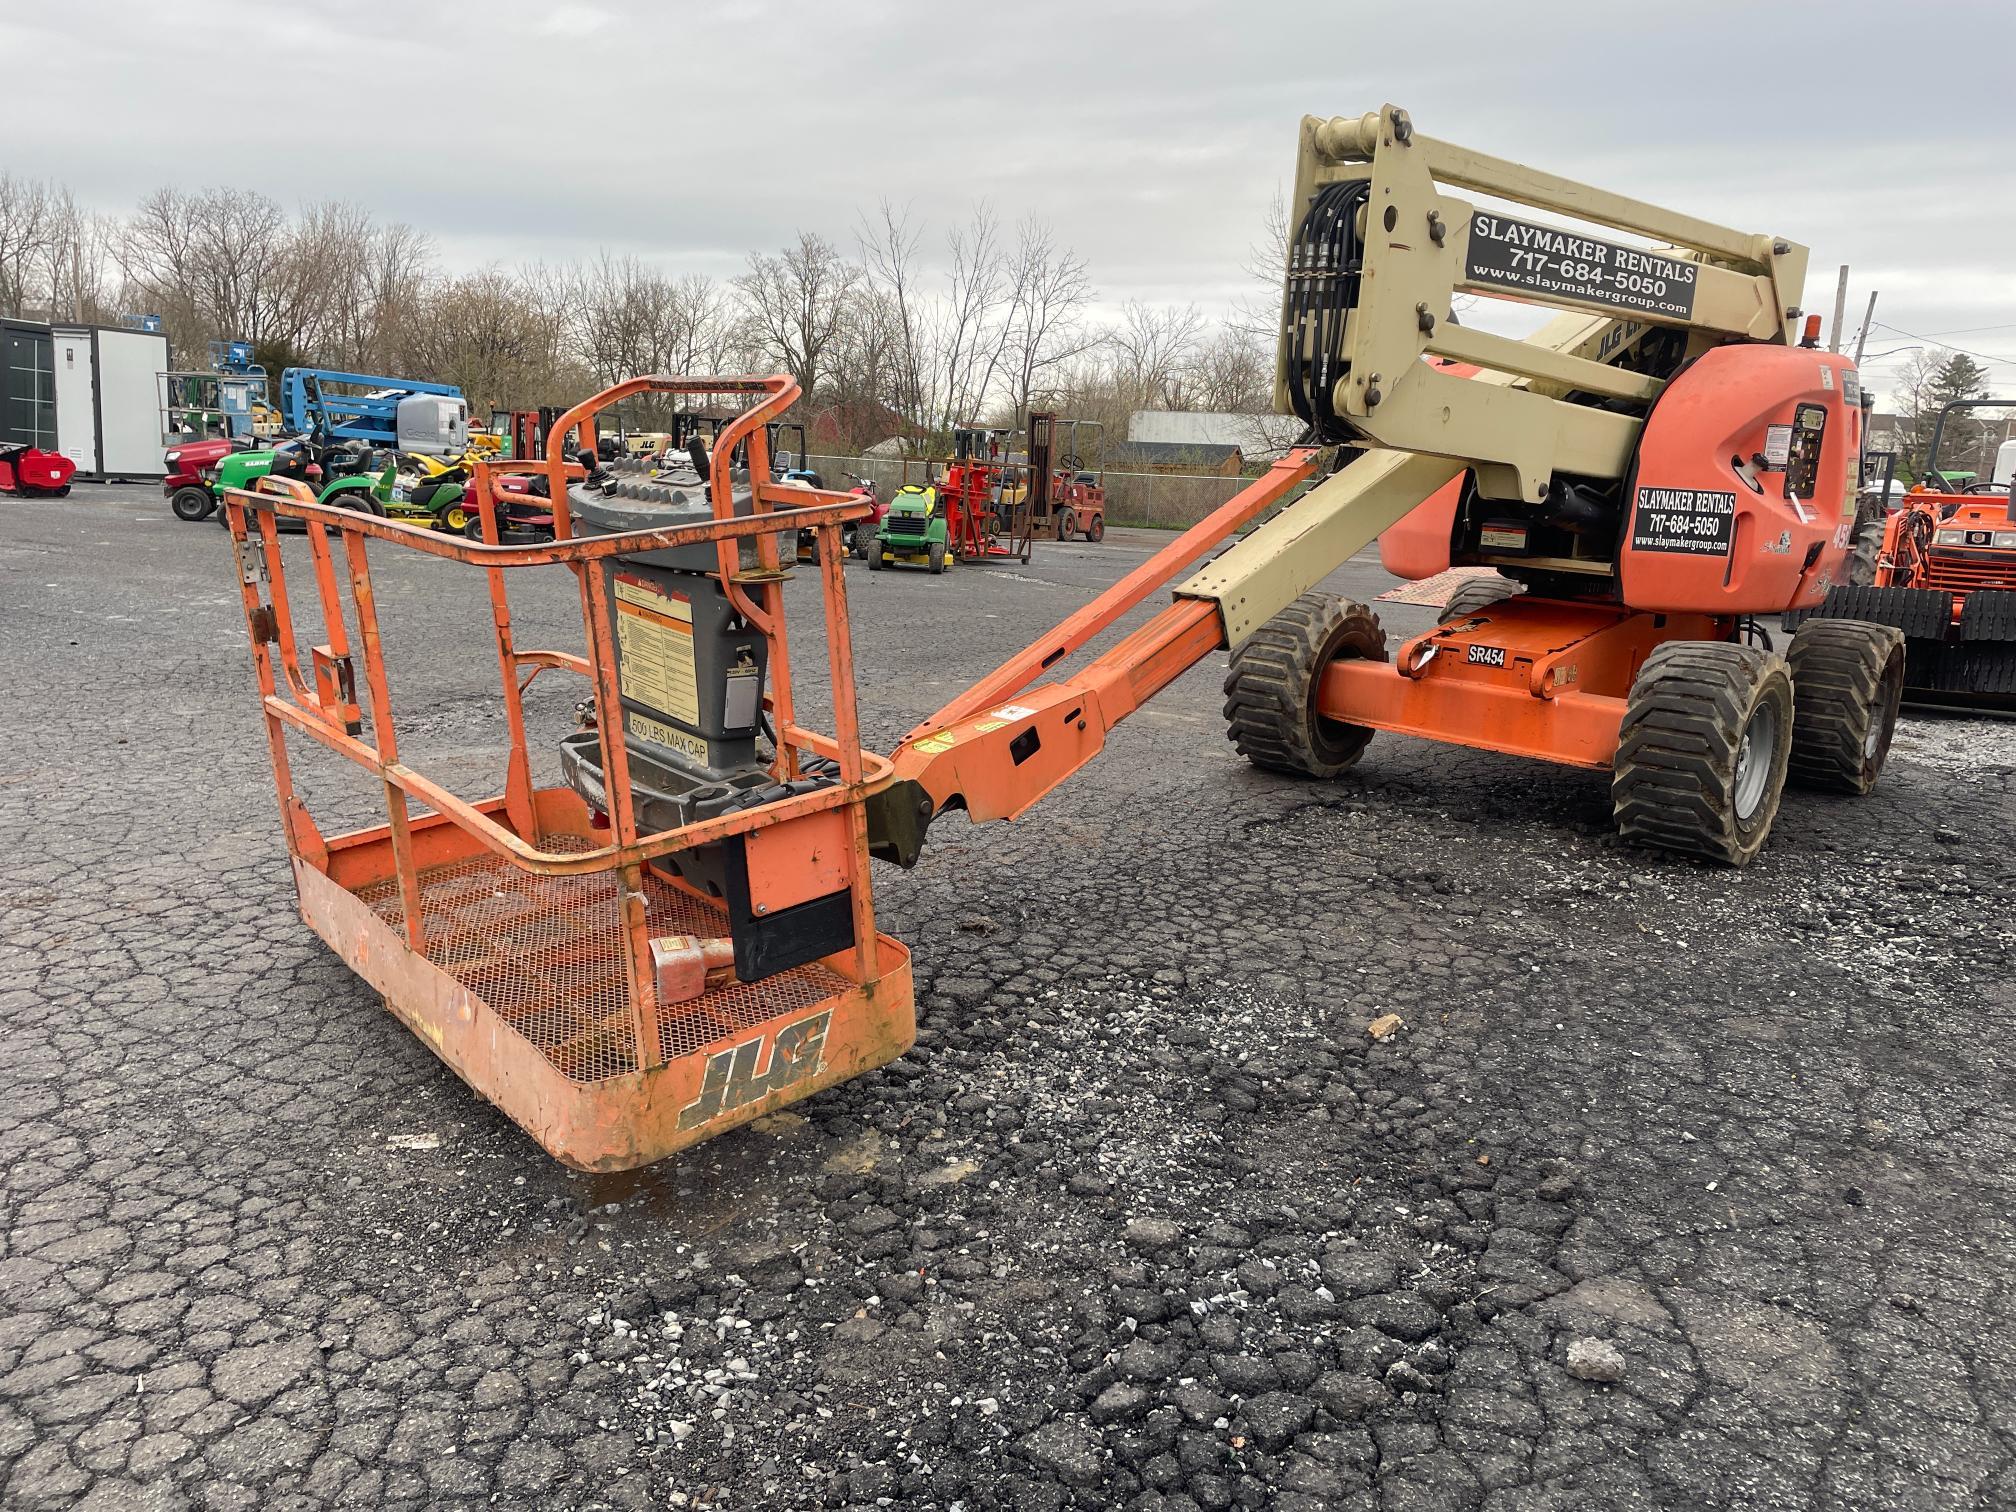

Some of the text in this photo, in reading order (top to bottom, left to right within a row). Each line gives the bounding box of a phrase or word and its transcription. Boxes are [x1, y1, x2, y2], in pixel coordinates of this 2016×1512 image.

[1475, 216, 1694, 284] SLAYMAKER RENTALS
[1473, 265, 1687, 314] www.slaymakergroup.com
[1509, 248, 1667, 297] 717-684-5050
[1597, 323, 1622, 362] JLG
[640, 441, 655, 449] JLG
[1639, 489, 1734, 514] SLAYMAKER RENTALS
[1635, 534, 1728, 551] www.slaymakergroup.com
[1649, 513, 1719, 536] 717-684-5050
[1468, 645, 1504, 666] SR454
[631, 719, 706, 758] 500 LBS MAX CAP
[675, 1008, 834, 1131] JLG
